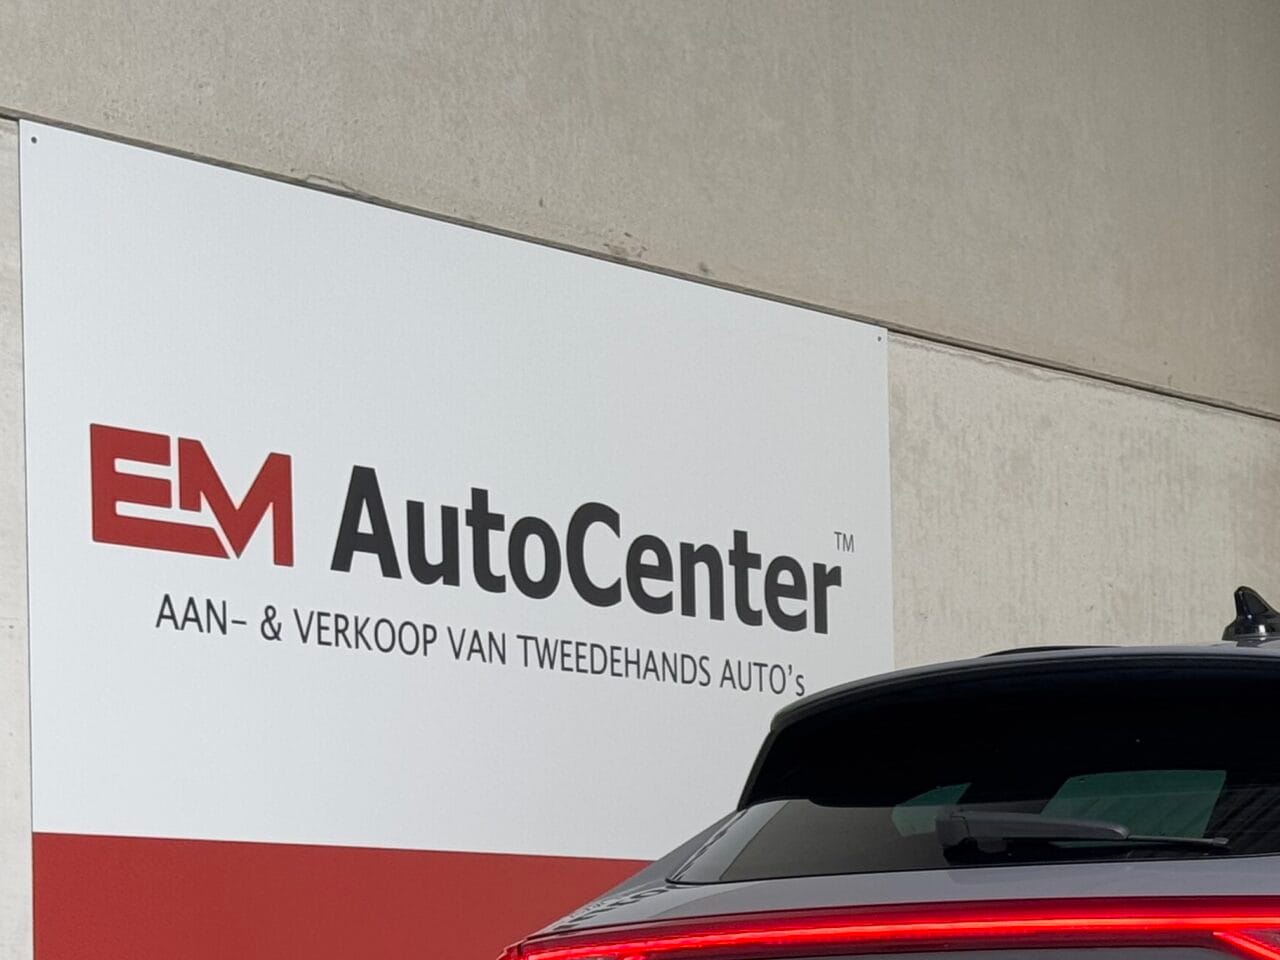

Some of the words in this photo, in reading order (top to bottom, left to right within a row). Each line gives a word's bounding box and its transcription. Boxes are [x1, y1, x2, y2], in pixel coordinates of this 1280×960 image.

[90, 423, 294, 567] EM
[330, 465, 842, 635] AutoCenter
[260, 605, 283, 642] &
[293, 609, 438, 657] VERKOOP
[447, 627, 508, 665] VAN
[516, 634, 711, 688] TWEEDEHANDS
[719, 655, 806, 697] AUTO's
